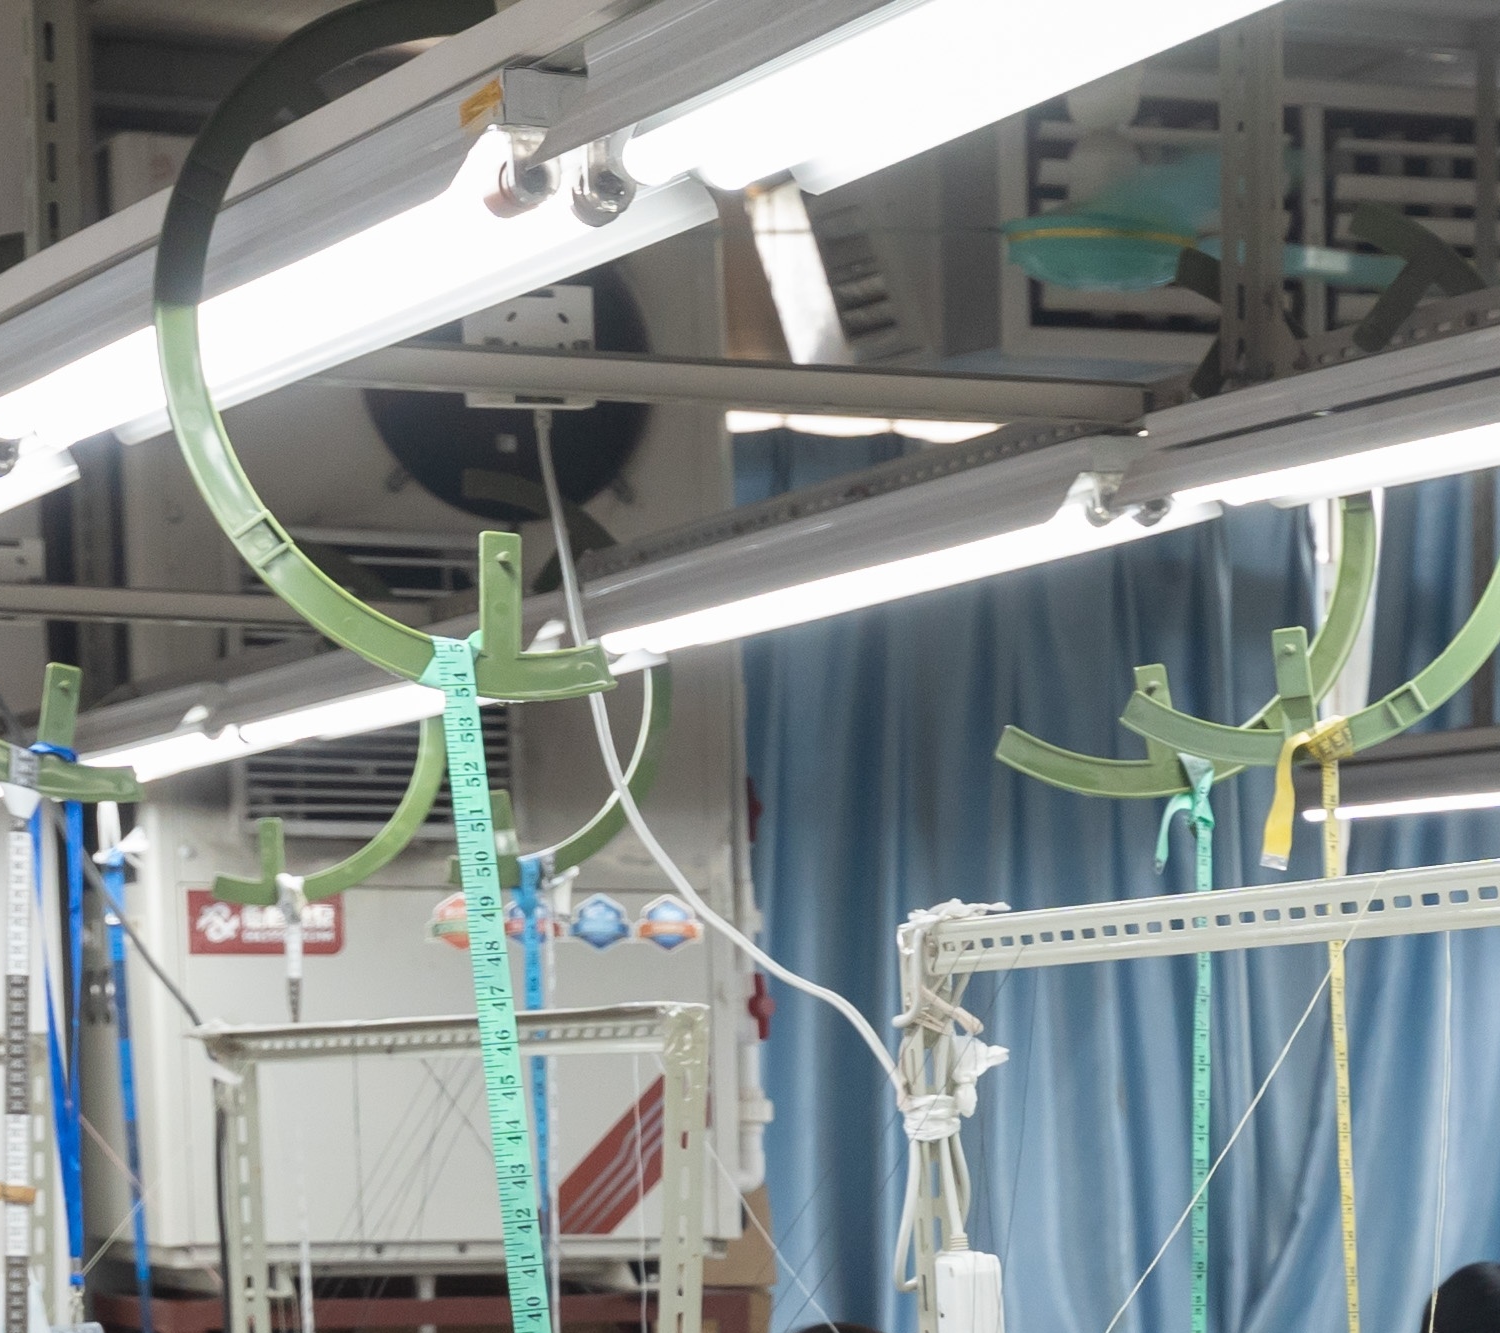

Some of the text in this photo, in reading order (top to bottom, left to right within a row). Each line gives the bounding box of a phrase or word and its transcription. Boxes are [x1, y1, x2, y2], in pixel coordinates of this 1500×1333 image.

[460, 717, 475, 742] 53
[464, 761, 480, 787] 52
[470, 808, 486, 832] 51
[475, 850, 491, 877] 50
[480, 895, 495, 921] 49
[485, 940, 501, 966] 48
[490, 985, 506, 1011] 47
[495, 1029, 511, 1055] 46
[500, 1074, 516, 1100] 45
[505, 1119, 522, 1144] 44
[510, 1164, 527, 1189] 43
[515, 1208, 532, 1233] 42
[521, 1253, 537, 1278] 41
[526, 1296, 543, 1321] 40
